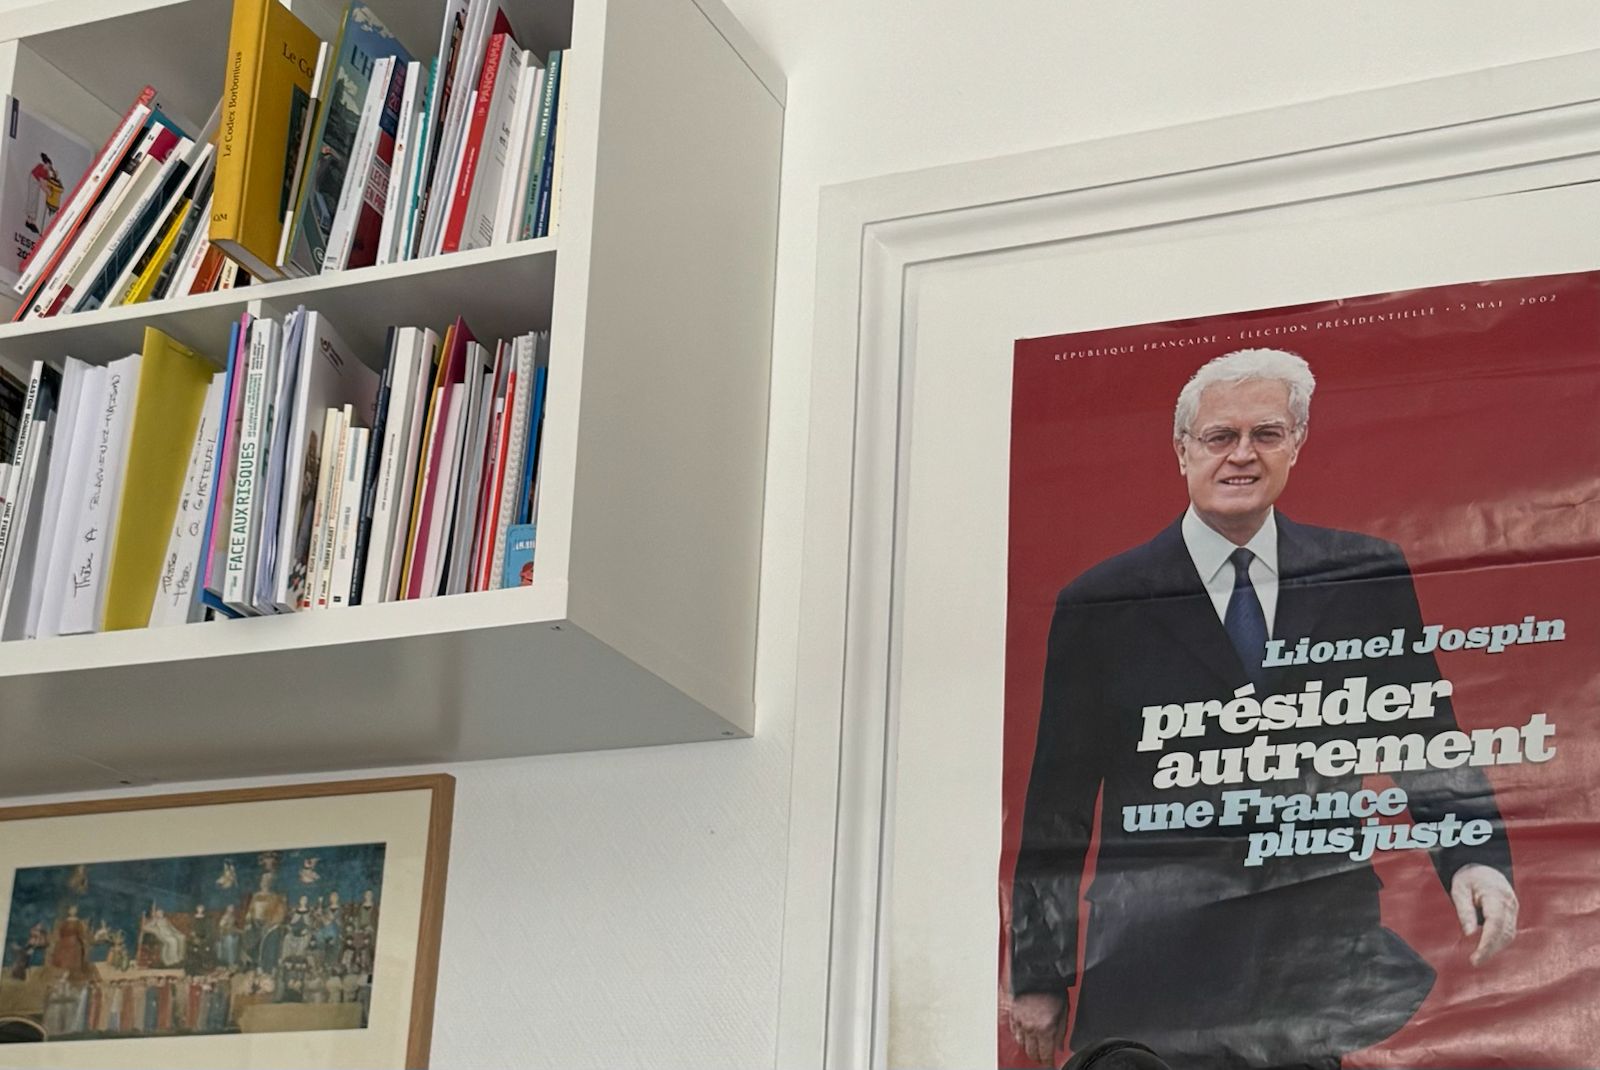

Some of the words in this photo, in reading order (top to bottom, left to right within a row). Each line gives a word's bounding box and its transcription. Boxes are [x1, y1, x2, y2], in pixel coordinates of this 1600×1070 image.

[228, 51, 242, 109] Borbonicus
[281, 42, 296, 64] Le
[298, 58, 314, 79] Co
[350, 45, 372, 82] L'H
[481, 33, 504, 104] PANORAMAS
[222, 144, 232, 158] Le
[224, 110, 236, 143] Codex
[1053, 344, 1135, 361] RÉPUBLIQUE
[1143, 334, 1218, 351] FRANÇAISE
[1240, 323, 1308, 340] ÉLECTION
[1316, 306, 1436, 330] PRÉSIDENTIELLE
[1460, 303, 1467, 311] 5
[1476, 300, 1504, 310] MAI
[1519, 294, 1557, 306] 2002
[26, 377, 38, 411] GASTON
[239, 442, 255, 506] RISQUES
[235, 505, 249, 537] AUX
[229, 538, 245, 571] FACE
[1261, 627, 1405, 669] Lionel
[1412, 615, 1566, 655] Jospin
[1136, 676, 1453, 753] présider
[1152, 713, 1558, 790] autrement
[1121, 800, 1215, 833] une
[1218, 786, 1409, 828] France
[1243, 822, 1358, 868] plus
[1349, 813, 1493, 863] juste
